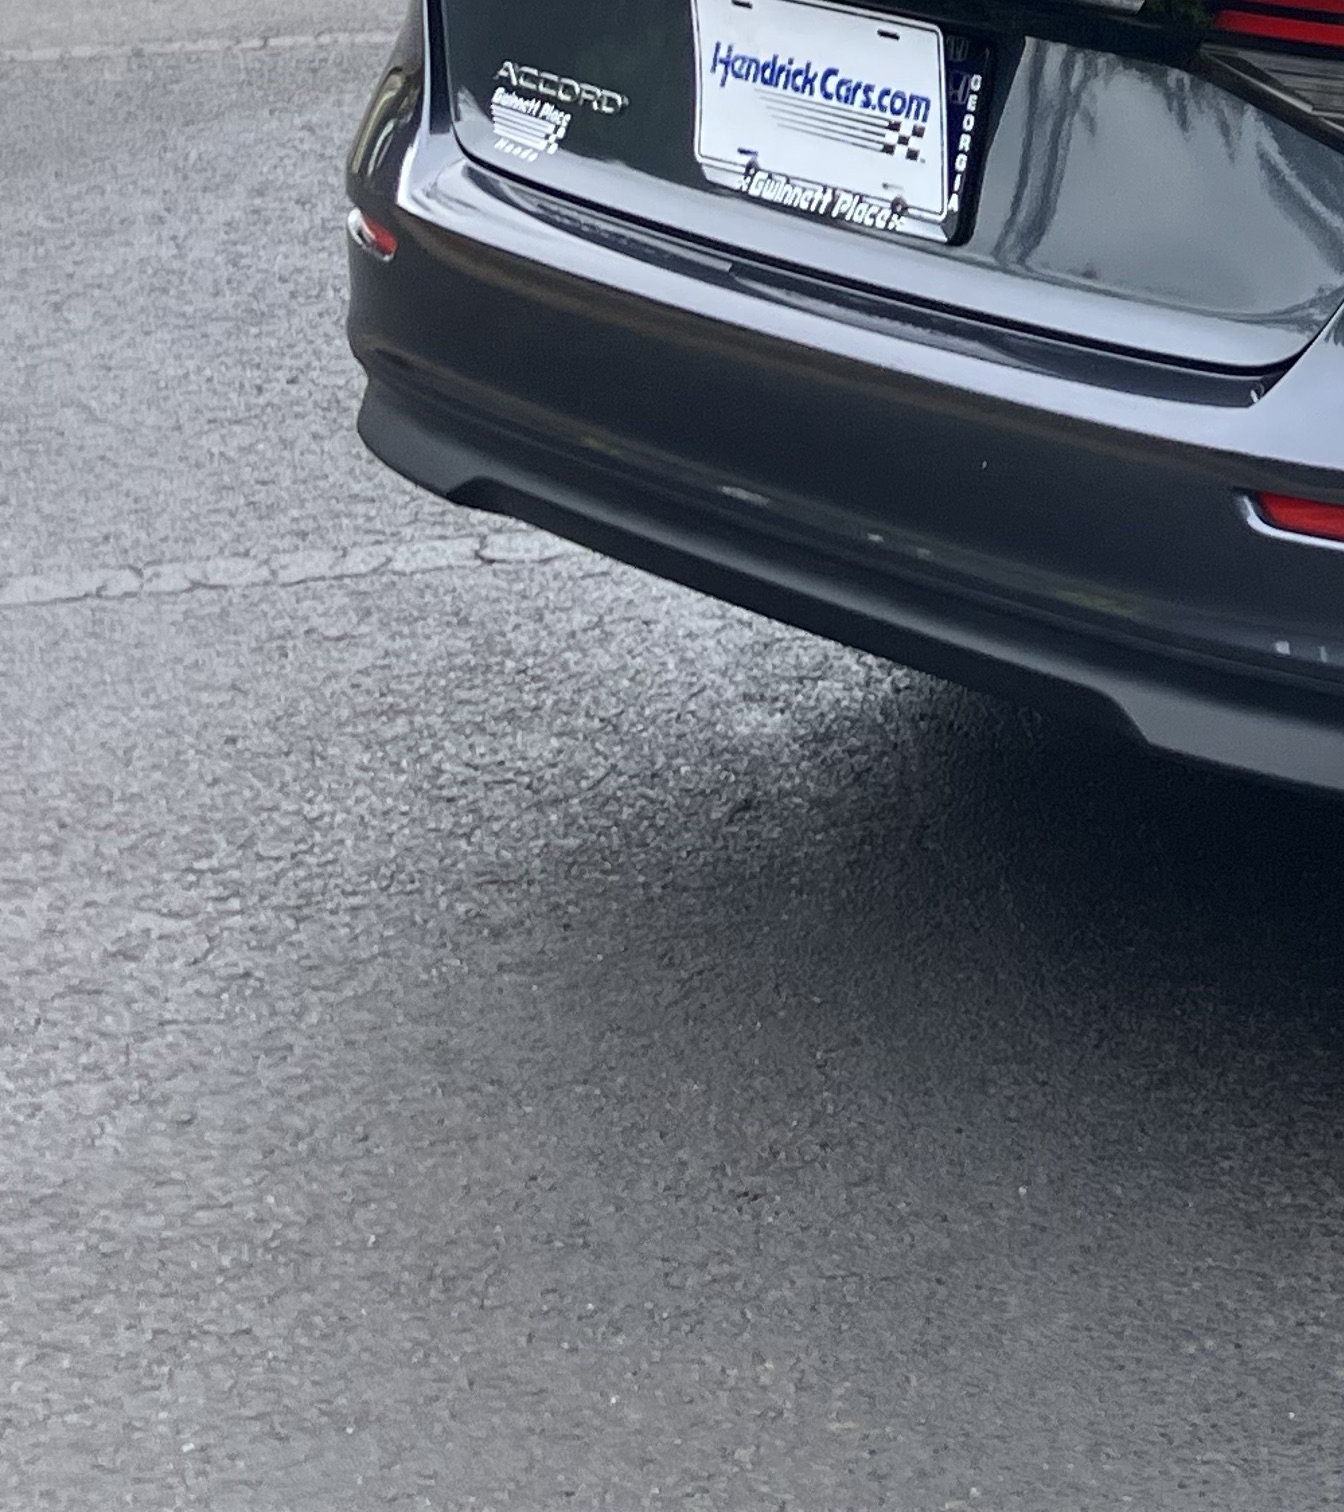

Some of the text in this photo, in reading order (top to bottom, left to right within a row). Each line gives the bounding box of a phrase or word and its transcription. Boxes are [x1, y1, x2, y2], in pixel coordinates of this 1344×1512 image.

[494, 61, 622, 114] ACCORD
[947, 73, 982, 212] GEORGIA
[748, 172, 891, 229] Gwinnett Place
